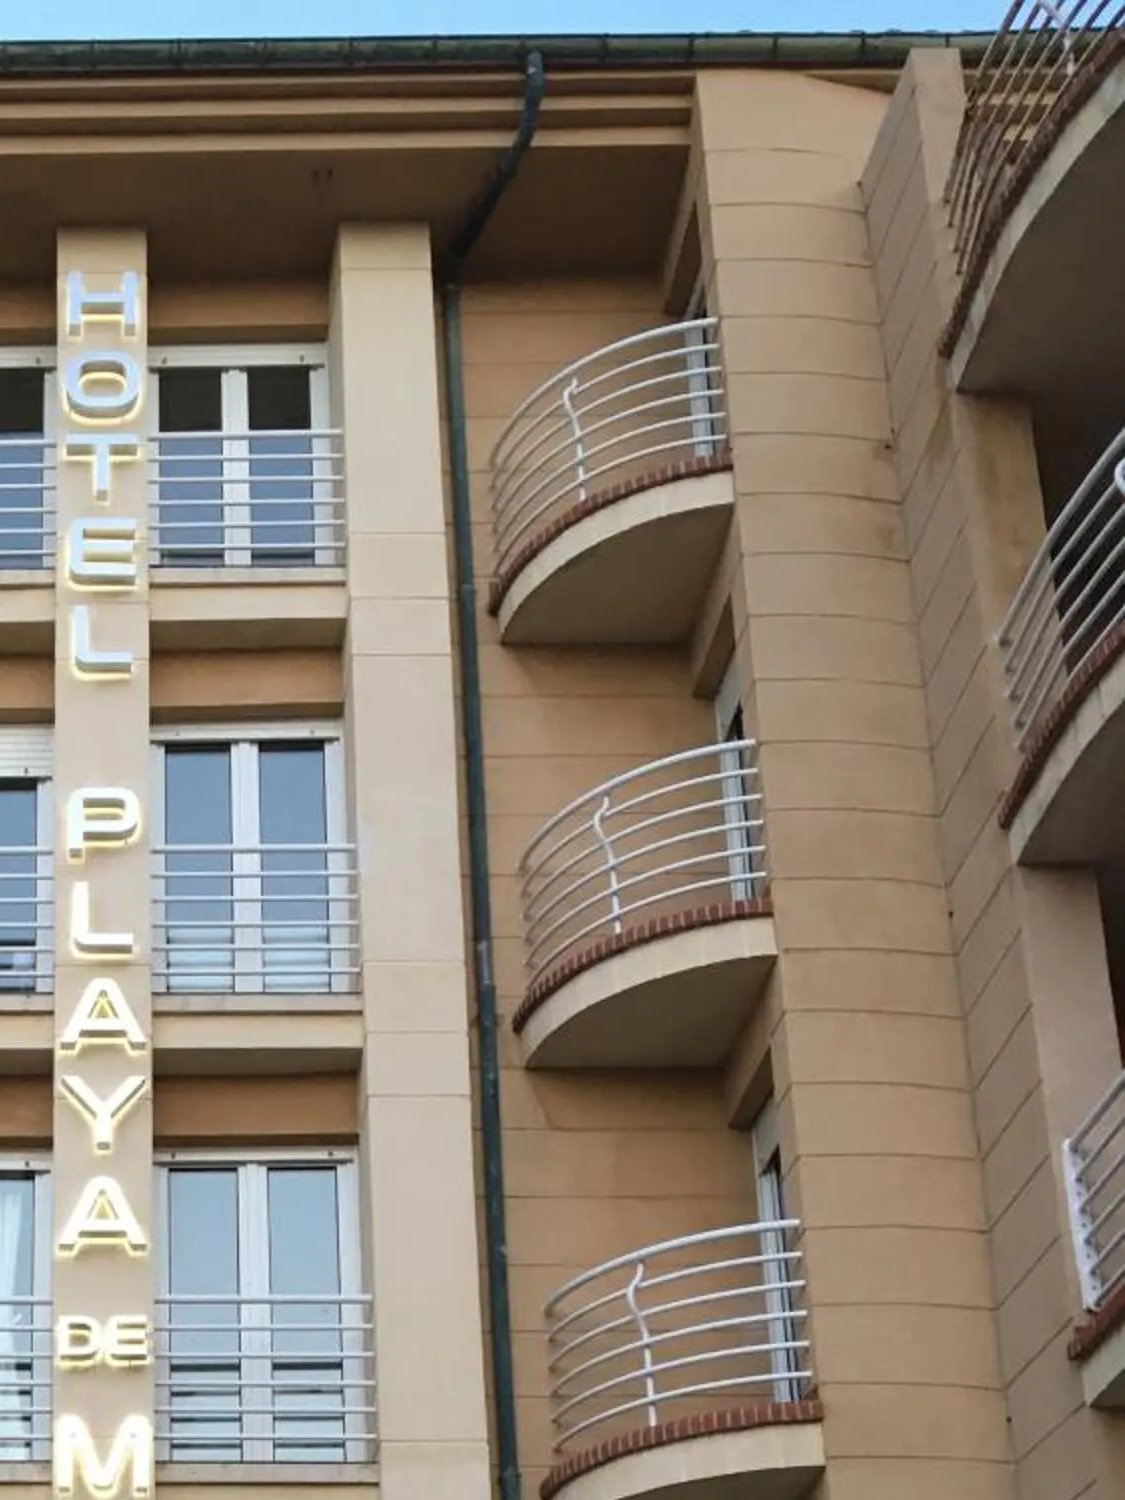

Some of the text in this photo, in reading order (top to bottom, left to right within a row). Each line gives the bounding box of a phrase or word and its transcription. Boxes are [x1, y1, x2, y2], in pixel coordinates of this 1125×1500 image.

[61, 268, 142, 678] HOTEL
[58, 786, 149, 1258] PLAYA
[56, 1314, 150, 1367] DE
